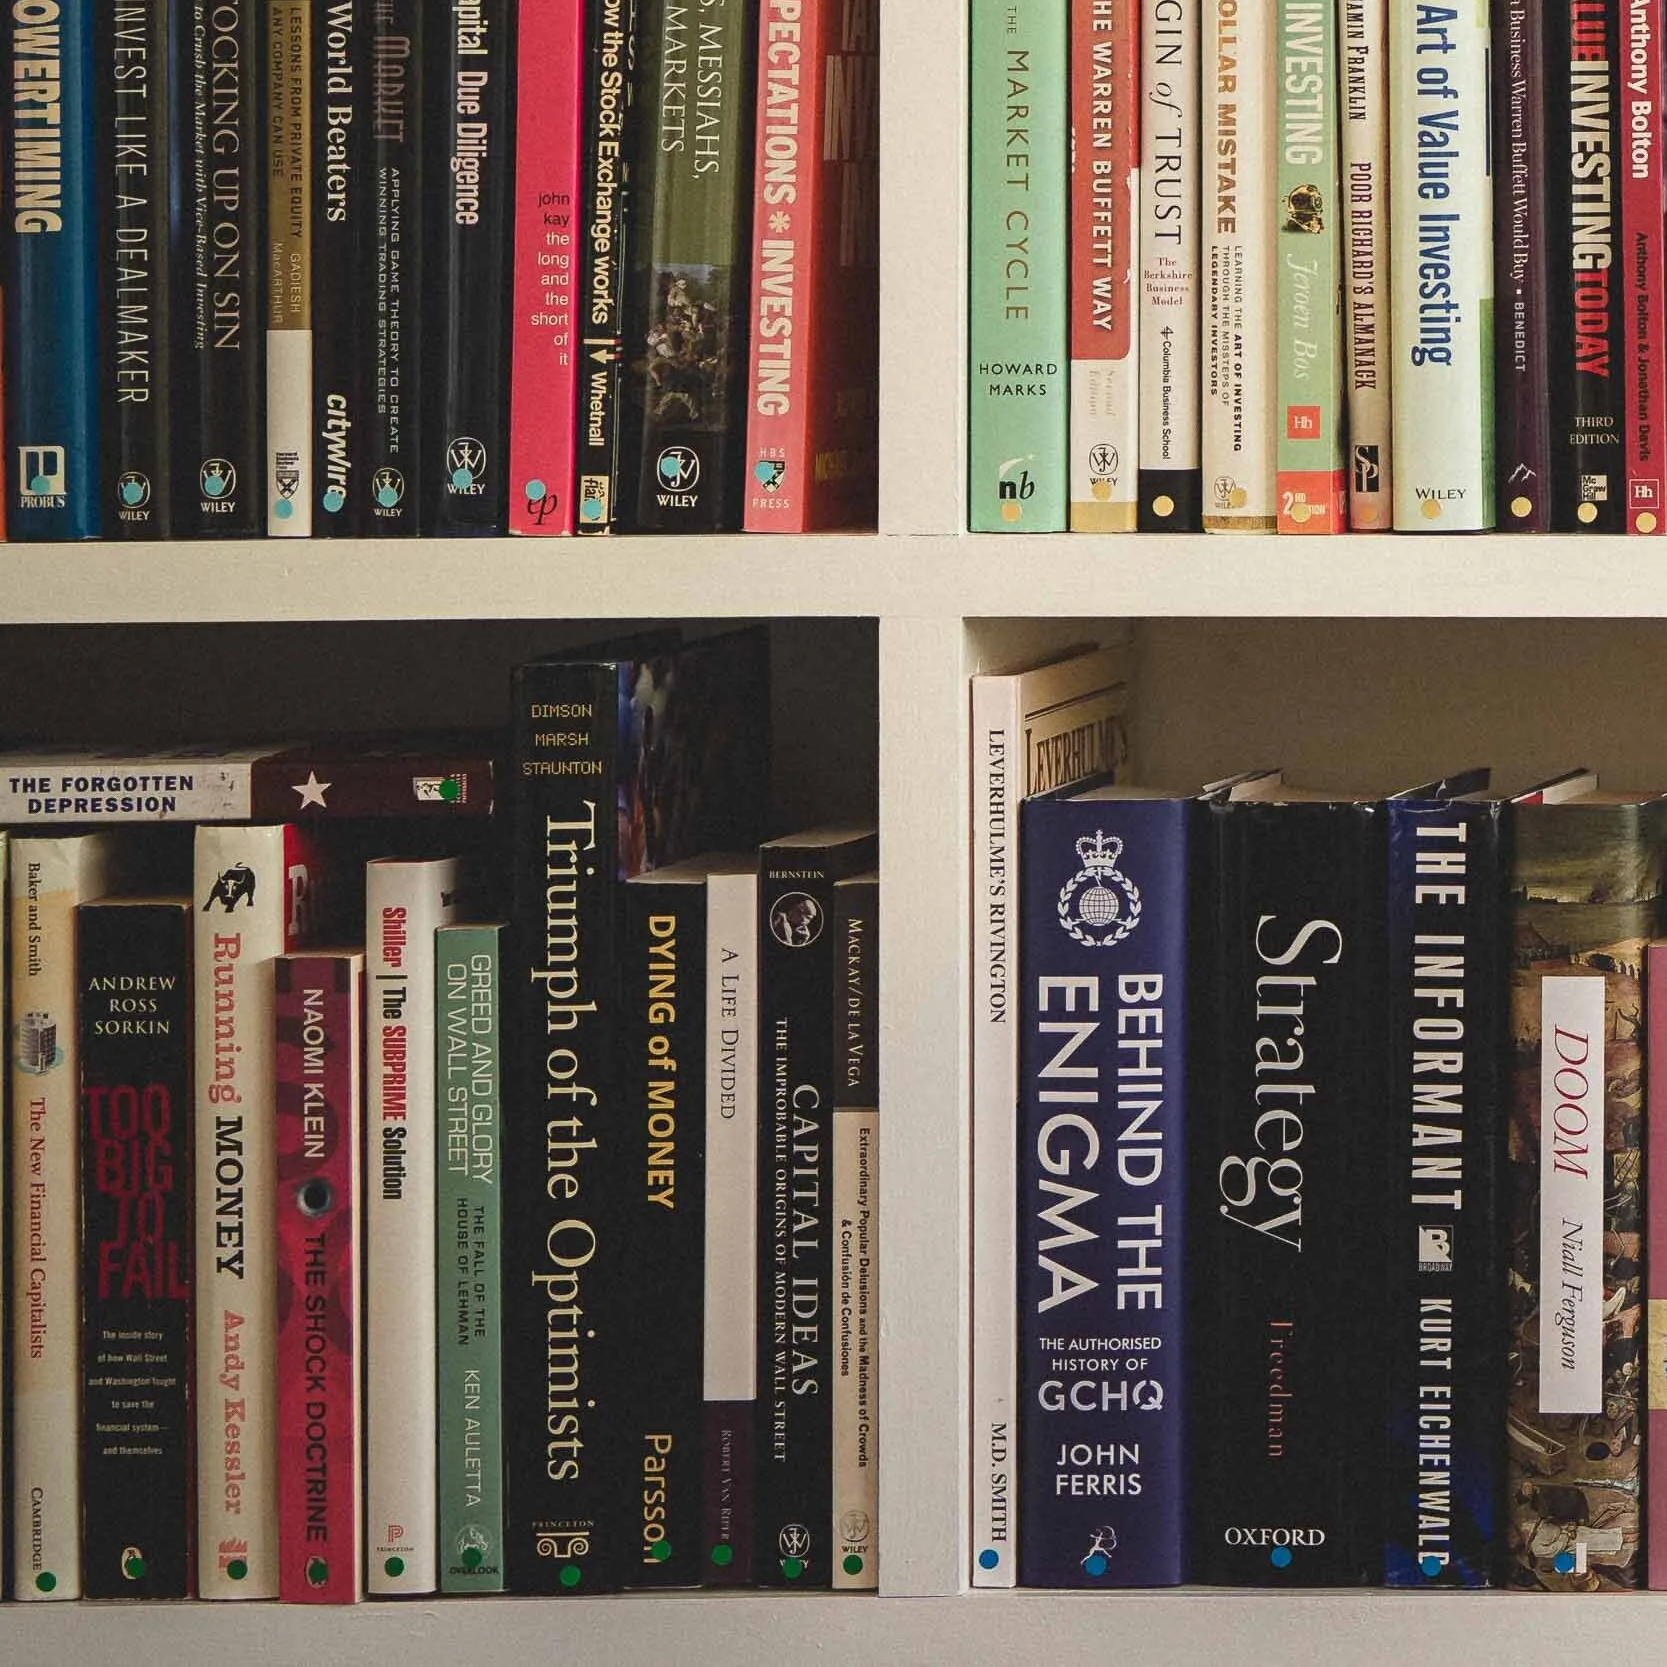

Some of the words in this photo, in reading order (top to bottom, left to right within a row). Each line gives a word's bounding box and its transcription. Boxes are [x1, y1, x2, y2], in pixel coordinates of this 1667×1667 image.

[1006, 6, 1017, 33] THE
[1007, 51, 1029, 191] MARKET
[1006, 211, 1029, 319] CYCLE
[756, 240, 794, 415] INVESTING
[980, 363, 1057, 375] HOWARD
[990, 384, 1046, 395] MARKS
[1575, 415, 1613, 428] THIRD
[532, 704, 592, 718] DIMSON
[535, 733, 589, 746] MARSH
[9, 778, 51, 793] THE
[61, 775, 193, 792] FORGOTTEN
[28, 797, 176, 814] DEPRESSION
[649, 916, 675, 1023] DYING
[648, 1036, 676, 1071] of
[1118, 974, 1163, 1186] BEHIND
[1554, 1025, 1588, 1179] DOOM
[648, 1081, 675, 1208] MONEY
[1037, 976, 1100, 1313] ENIGMA
[1117, 1205, 1162, 1309] THE
[1057, 1444, 1139, 1466] JOHN
[1056, 1473, 1141, 1495] FERRIS
[1225, 1527, 1325, 1546] OXFORD
